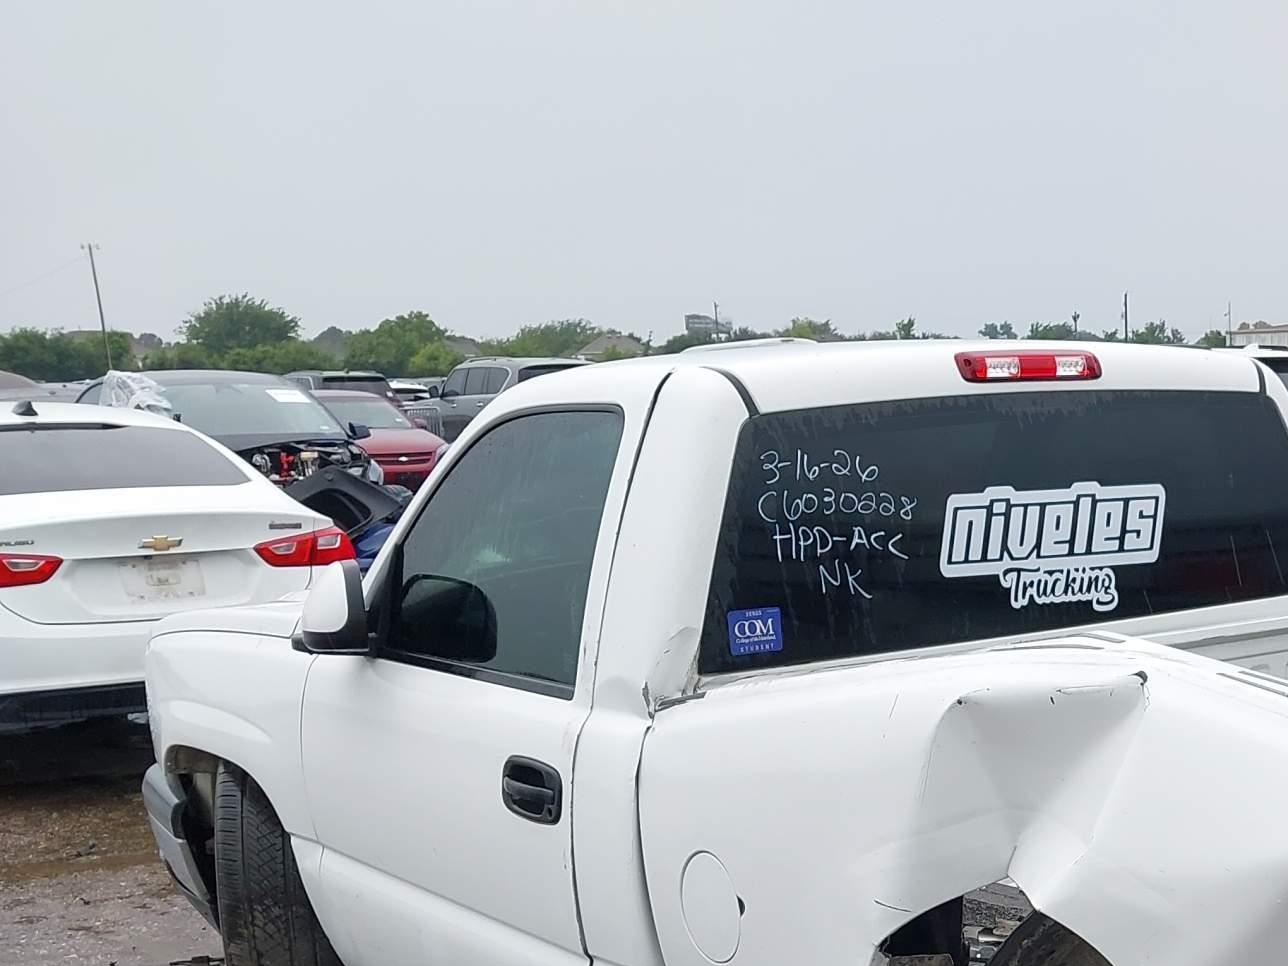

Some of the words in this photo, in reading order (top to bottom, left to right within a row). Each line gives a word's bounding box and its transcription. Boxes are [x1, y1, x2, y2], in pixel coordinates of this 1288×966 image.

[760, 449, 879, 484] 3-16-26
[758, 488, 917, 522] C6030228
[773, 522, 909, 562] HPD-ACC
[819, 559, 873, 599] NK
[1002, 566, 1115, 606] Trucking
[735, 618, 775, 638] COM
